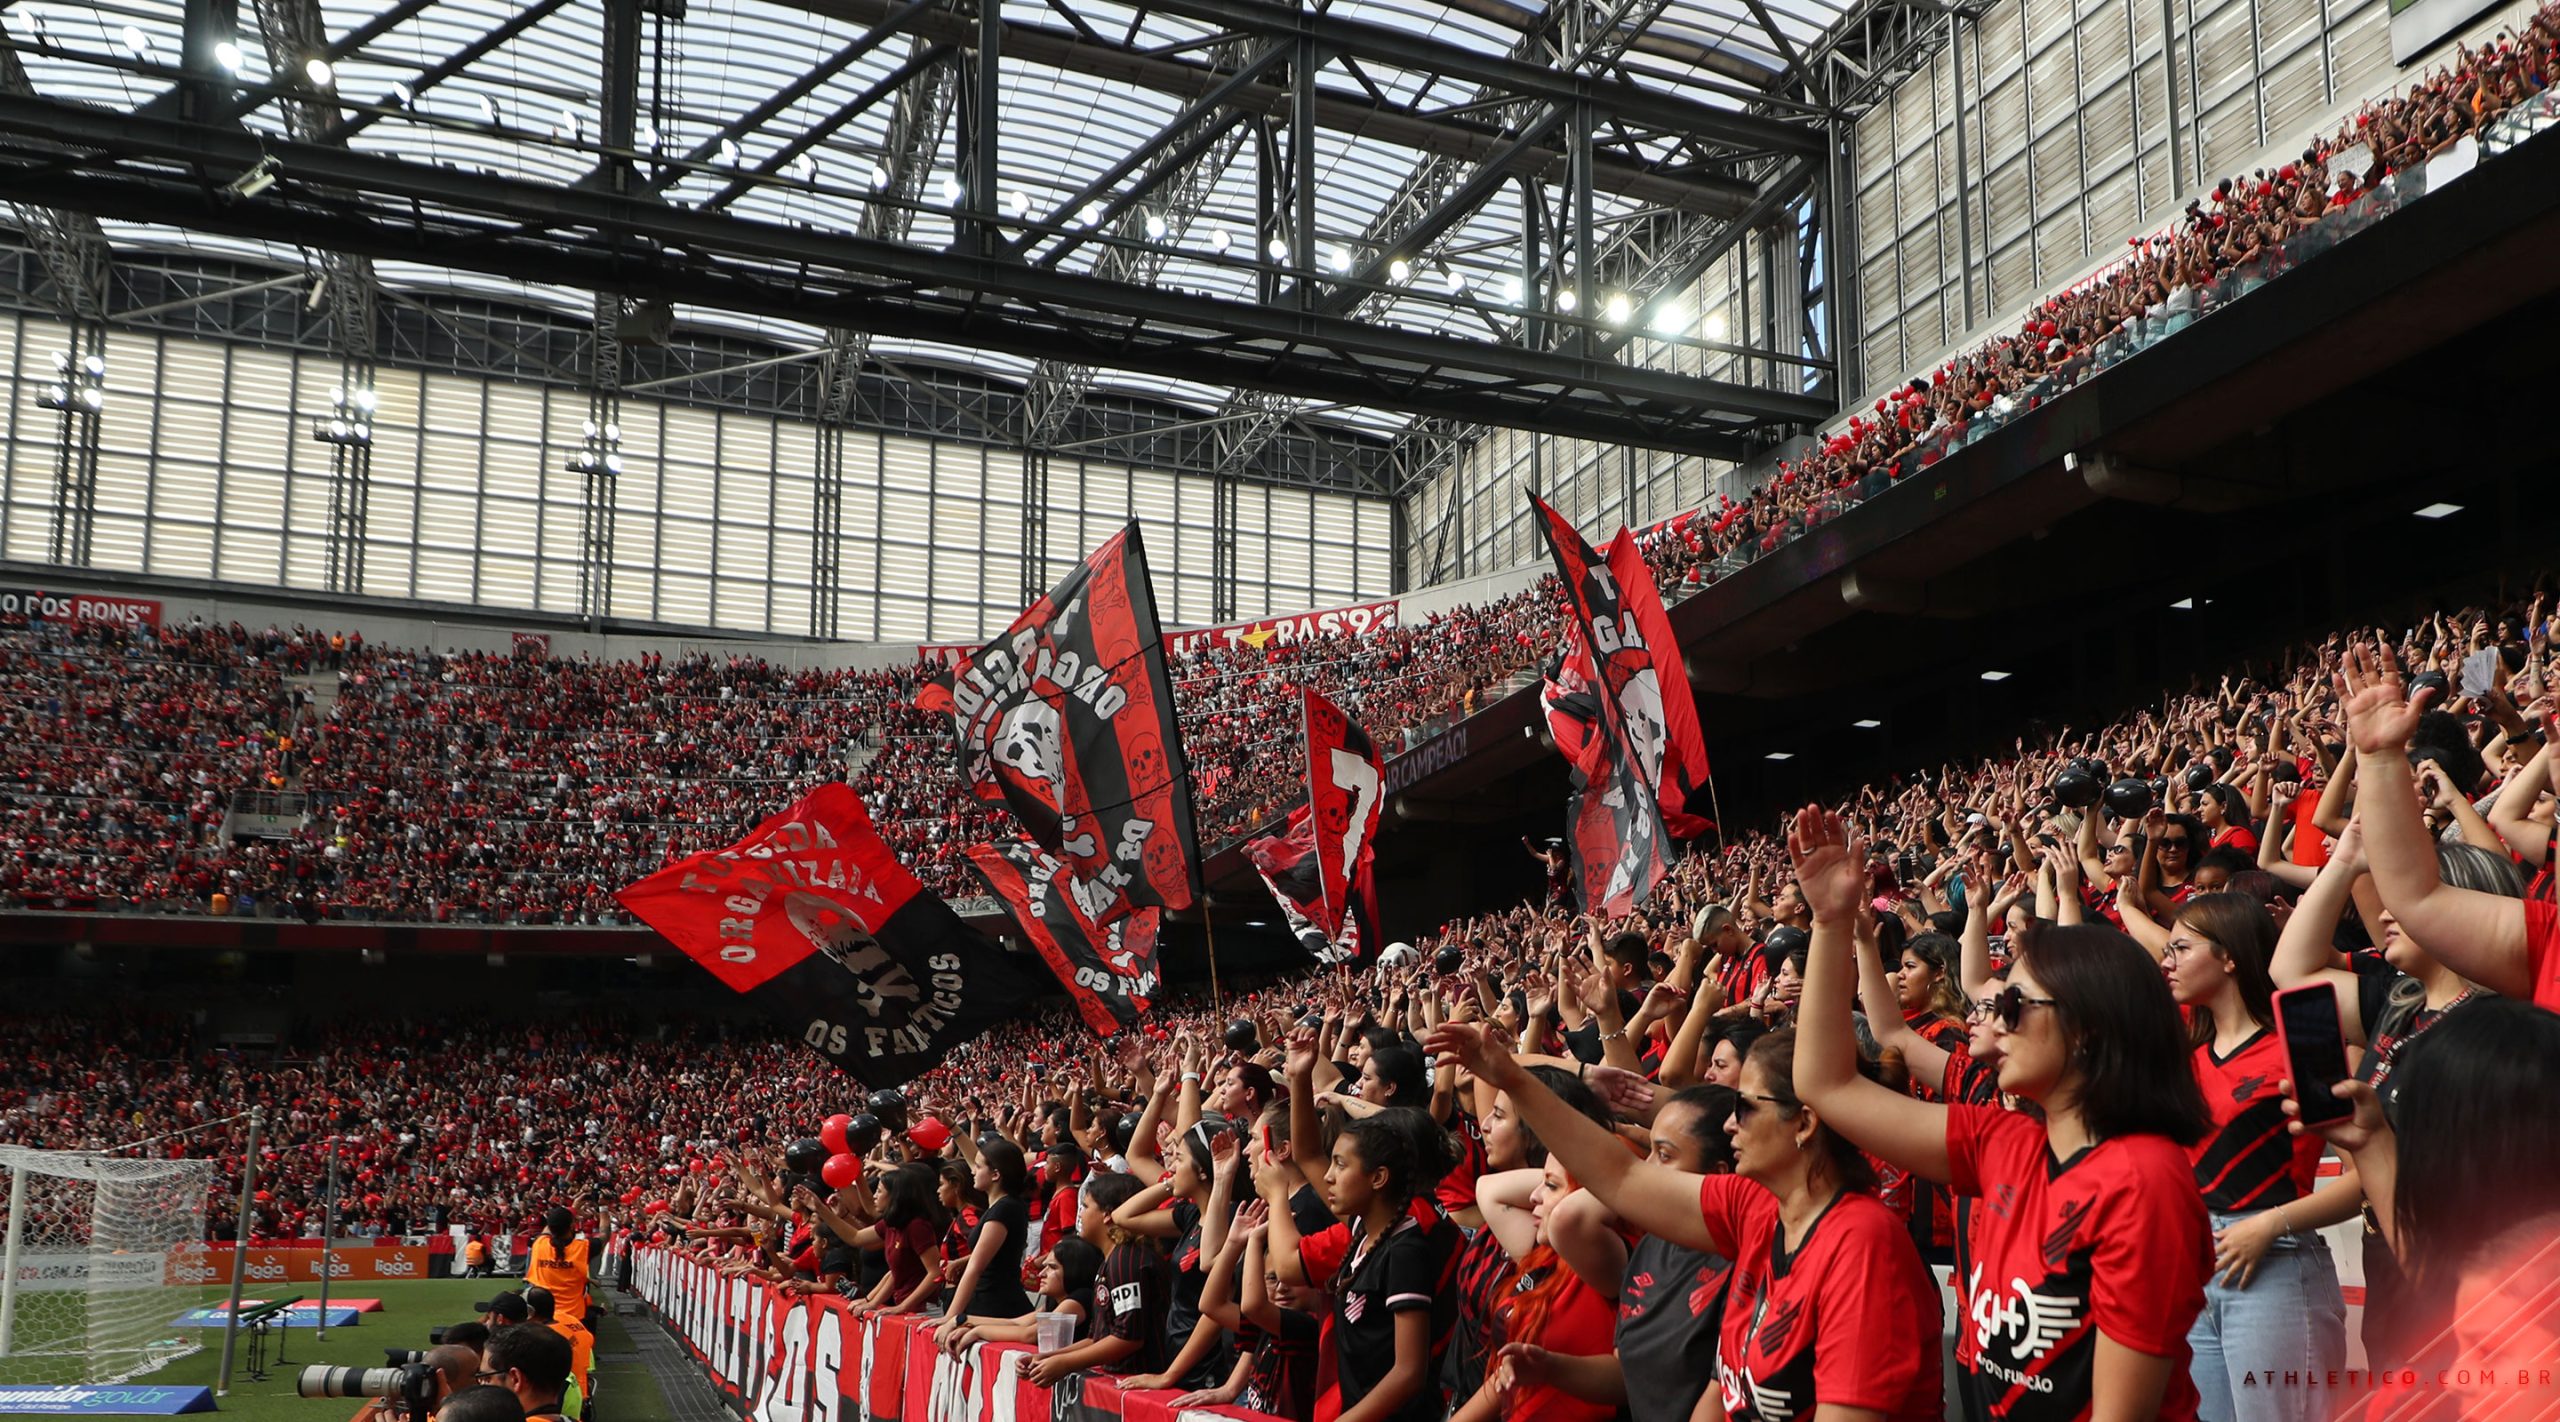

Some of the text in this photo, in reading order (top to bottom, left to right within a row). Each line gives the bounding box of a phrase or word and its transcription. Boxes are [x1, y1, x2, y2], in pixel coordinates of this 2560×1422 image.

[0, 594, 18, 610] O
[1074, 966, 1111, 992] OS
[804, 1018, 848, 1054] OS
[244, 1261, 285, 1279] ligga
[375, 1258, 413, 1276] ligga
[1112, 1284, 1139, 1304] HDI
